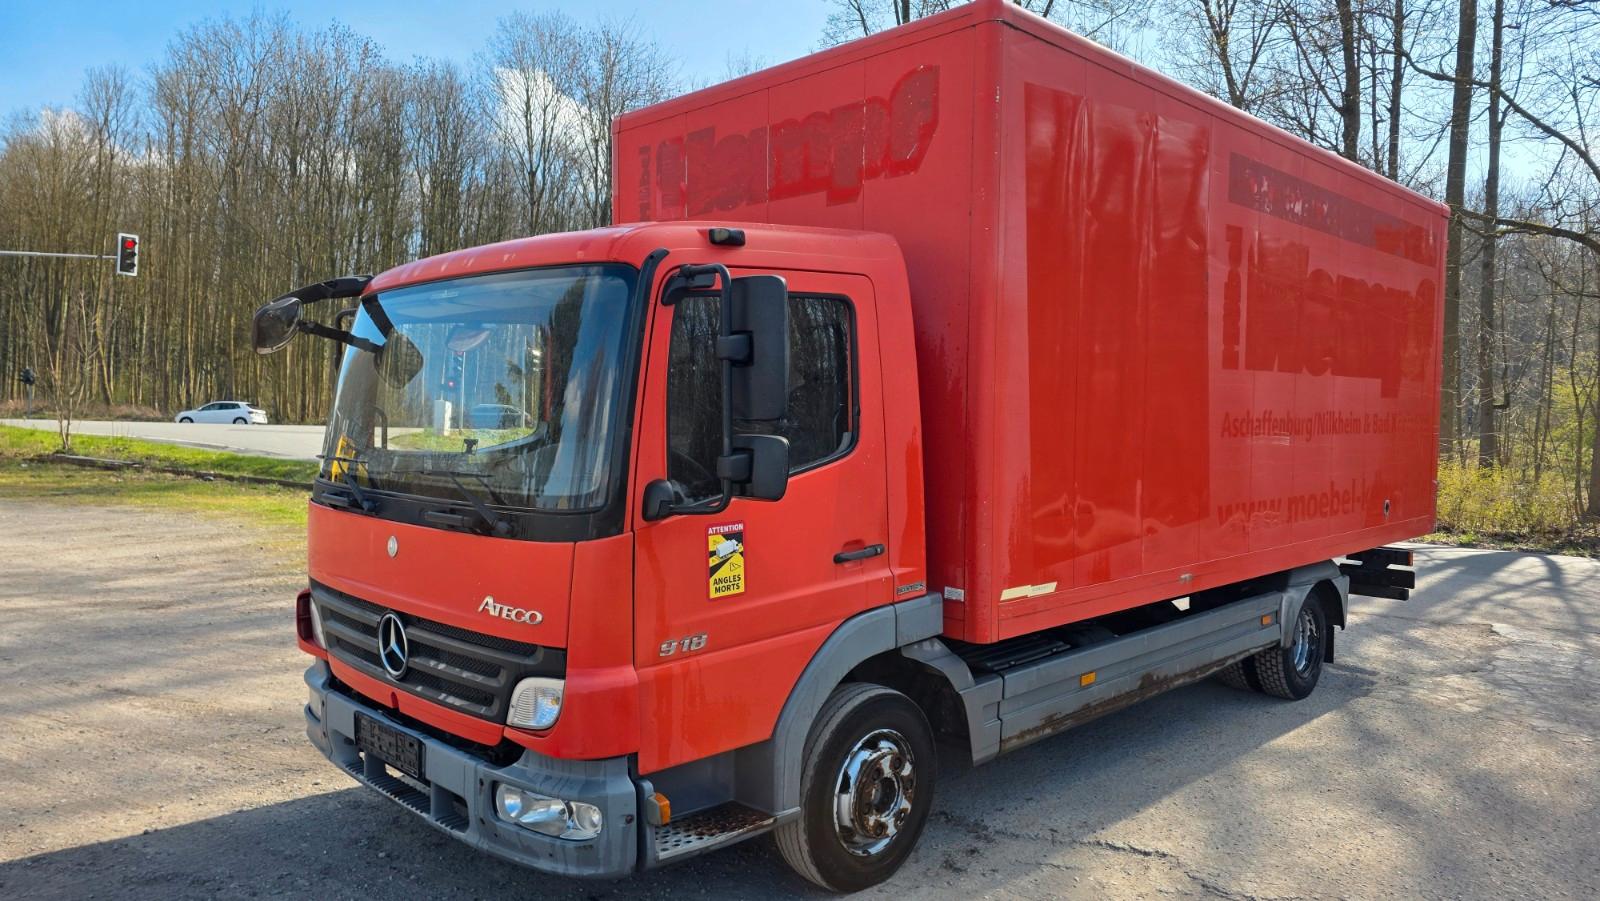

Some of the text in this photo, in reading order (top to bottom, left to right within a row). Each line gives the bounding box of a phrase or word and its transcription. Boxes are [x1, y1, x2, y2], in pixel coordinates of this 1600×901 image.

[708, 523, 744, 535] ATTENTION
[713, 574, 742, 587] ANGLES
[714, 583, 740, 594] MORTS
[660, 634, 708, 656] 918
